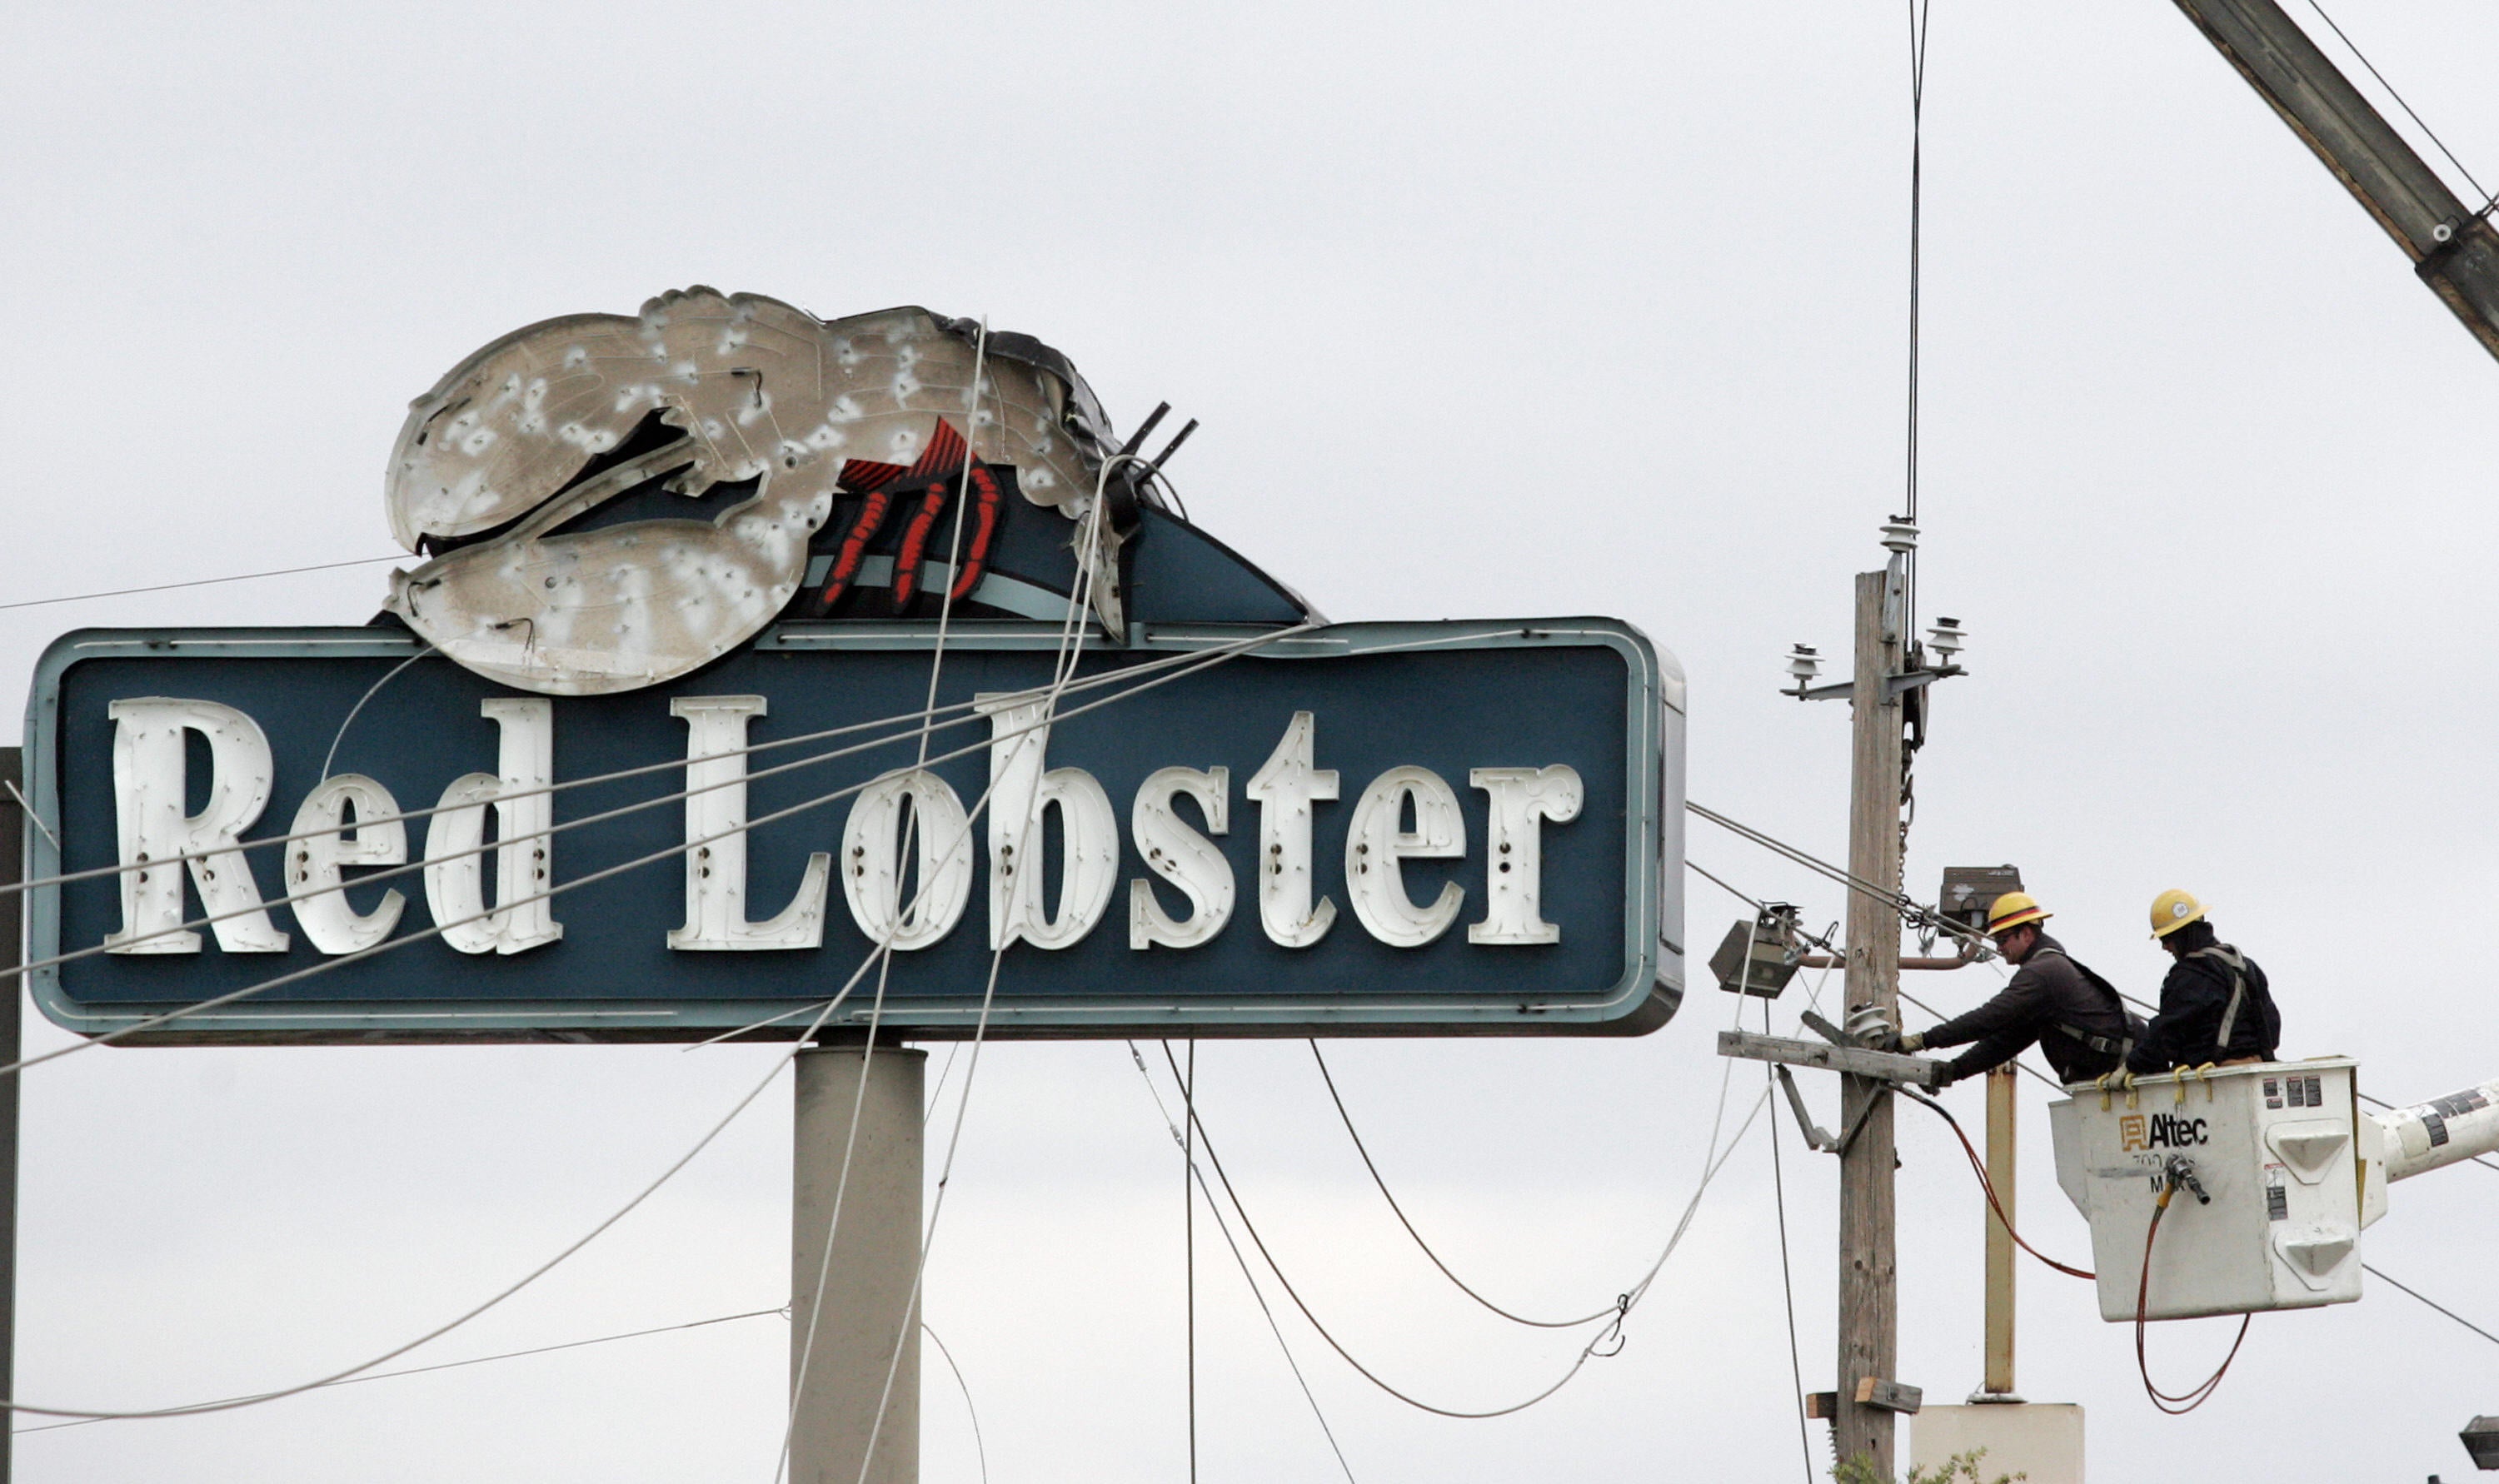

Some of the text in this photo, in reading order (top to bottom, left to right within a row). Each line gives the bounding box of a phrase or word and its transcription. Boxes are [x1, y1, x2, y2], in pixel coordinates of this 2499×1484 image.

[104, 692, 1584, 955] Red Lobster
[2149, 1113, 2208, 1149] Altec
